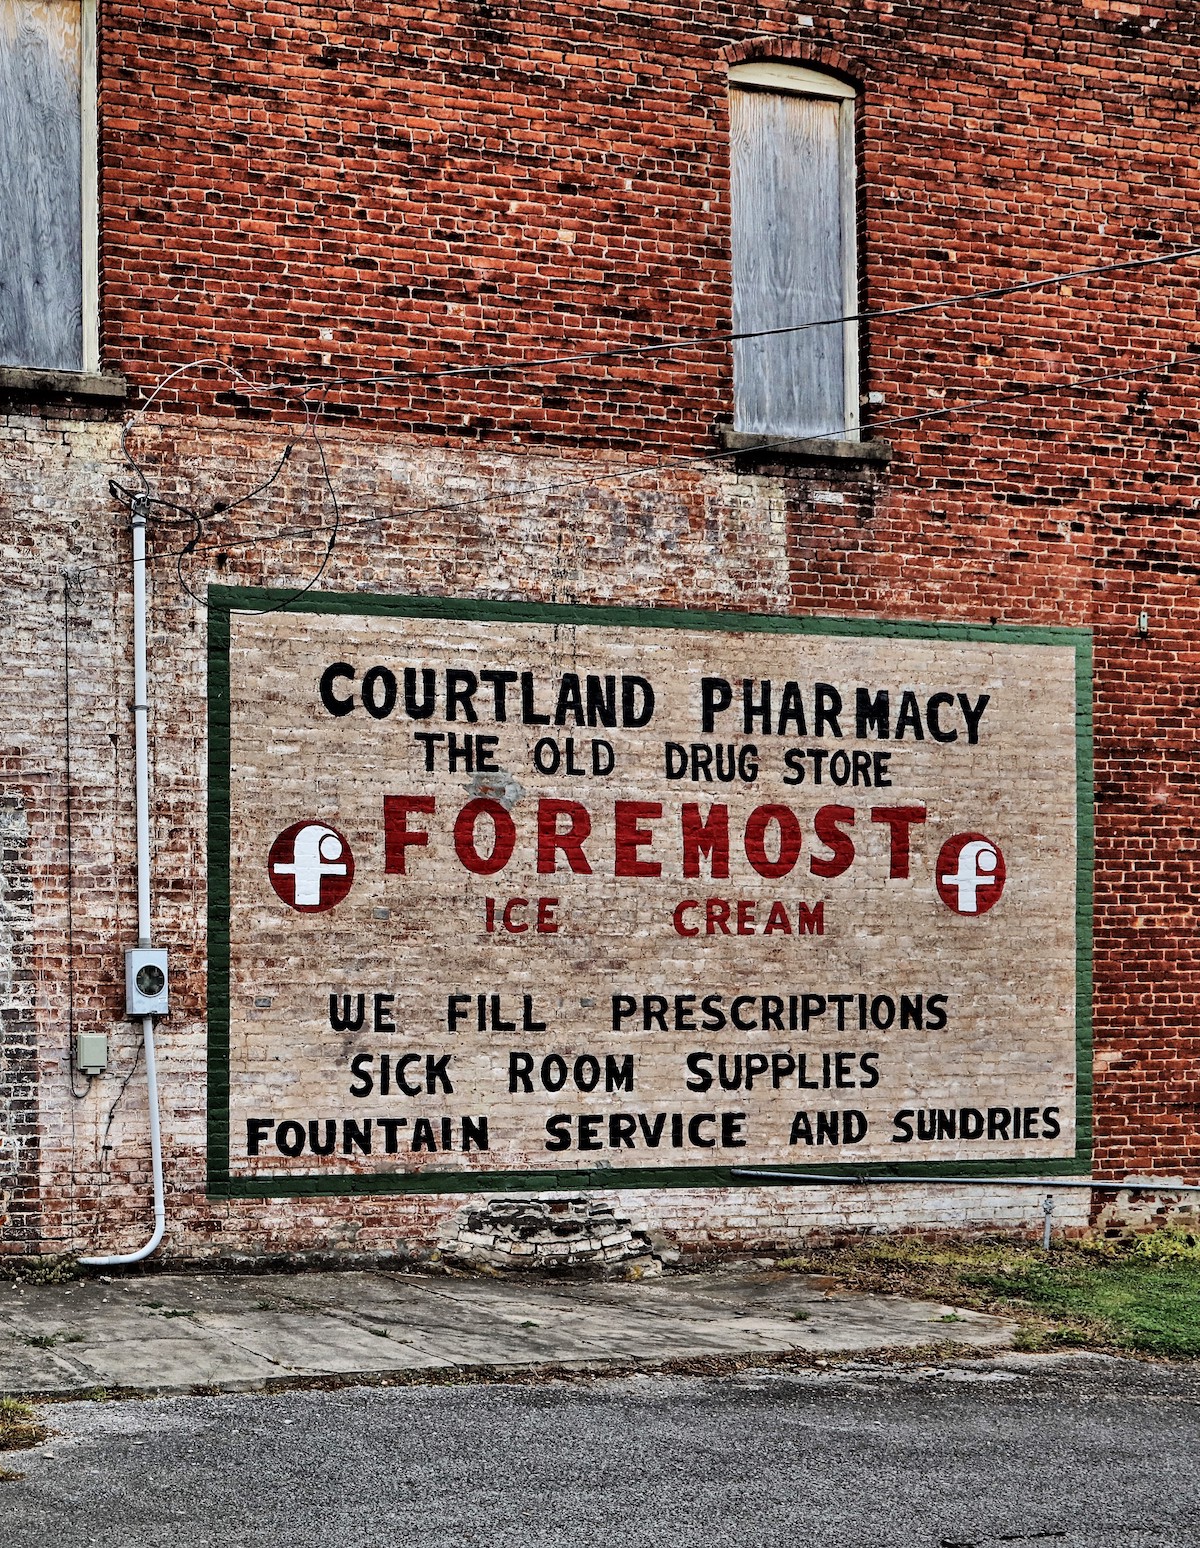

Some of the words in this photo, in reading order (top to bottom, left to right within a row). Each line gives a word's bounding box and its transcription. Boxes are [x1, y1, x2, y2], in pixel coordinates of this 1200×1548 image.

[319, 662, 655, 728] COURTLAND
[701, 677, 991, 744] PHARMACY
[414, 731, 500, 774] THE
[533, 736, 615, 777] OLD
[664, 741, 759, 783] DRUG
[783, 747, 892, 787] STORE
[383, 795, 927, 879] FOREMOST
[485, 898, 560, 933] ICE
[672, 899, 826, 937] CREAM
[329, 993, 396, 1033] WE
[447, 994, 547, 1032] FILL
[612, 994, 949, 1032] PRESCRIPTIONS
[350, 1053, 454, 1097] SICK
[508, 1052, 634, 1093] ROOM
[686, 1052, 880, 1092] SUPPLIES
[246, 1116, 489, 1158] FOUNTAIN
[545, 1112, 747, 1151] SERVICE
[789, 1109, 868, 1146] AND
[892, 1106, 1061, 1143] SUNDRIES
